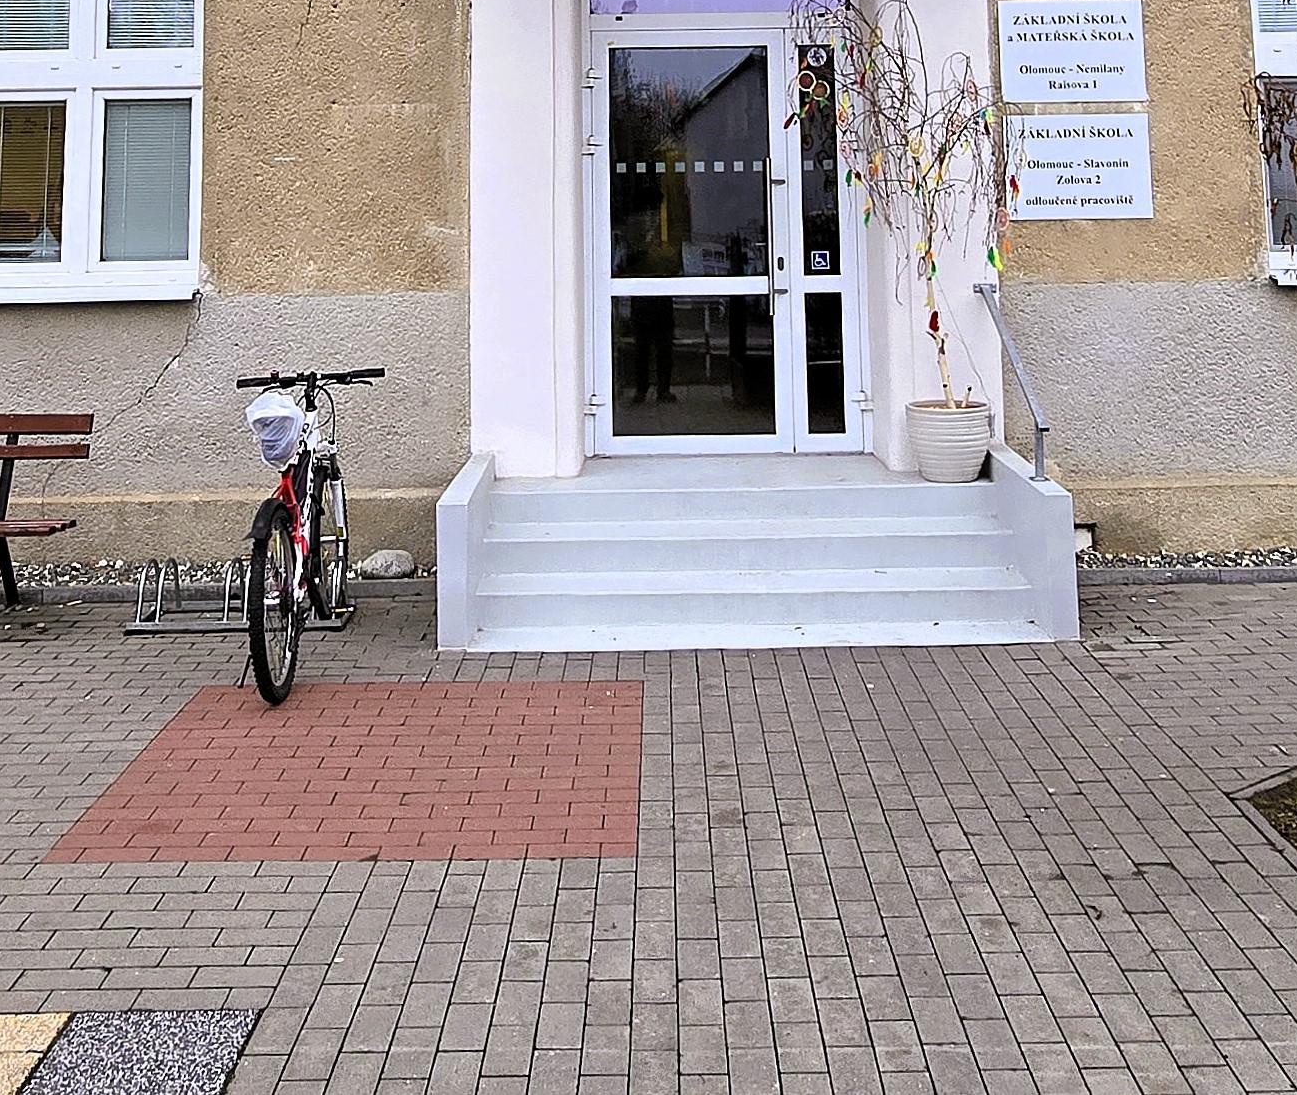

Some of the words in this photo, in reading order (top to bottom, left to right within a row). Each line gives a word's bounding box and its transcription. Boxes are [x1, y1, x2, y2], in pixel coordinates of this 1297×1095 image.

[1013, 12, 1080, 25] ZÁKLADNÍ
[1083, 12, 1127, 25] ŠKOLA
[1016, 29, 1087, 42] MATEŘSKÁ
[1090, 29, 1134, 41] ŠKOLA
[1019, 64, 1066, 74] Olomouc
[1076, 64, 1125, 76] Nemilany
[1048, 80, 1089, 90] Raisova
[1093, 80, 1097, 89] 1
[1018, 125, 1085, 139] ZÁKLADNÍ
[1089, 125, 1133, 138] ŠKOLA
[1027, 159, 1073, 169] Olomouc
[1056, 174, 1092, 185] Zolova
[1095, 174, 1101, 185] 2
[1025, 195, 1078, 206] odloučené
[1080, 194, 1134, 207] pracoviště
